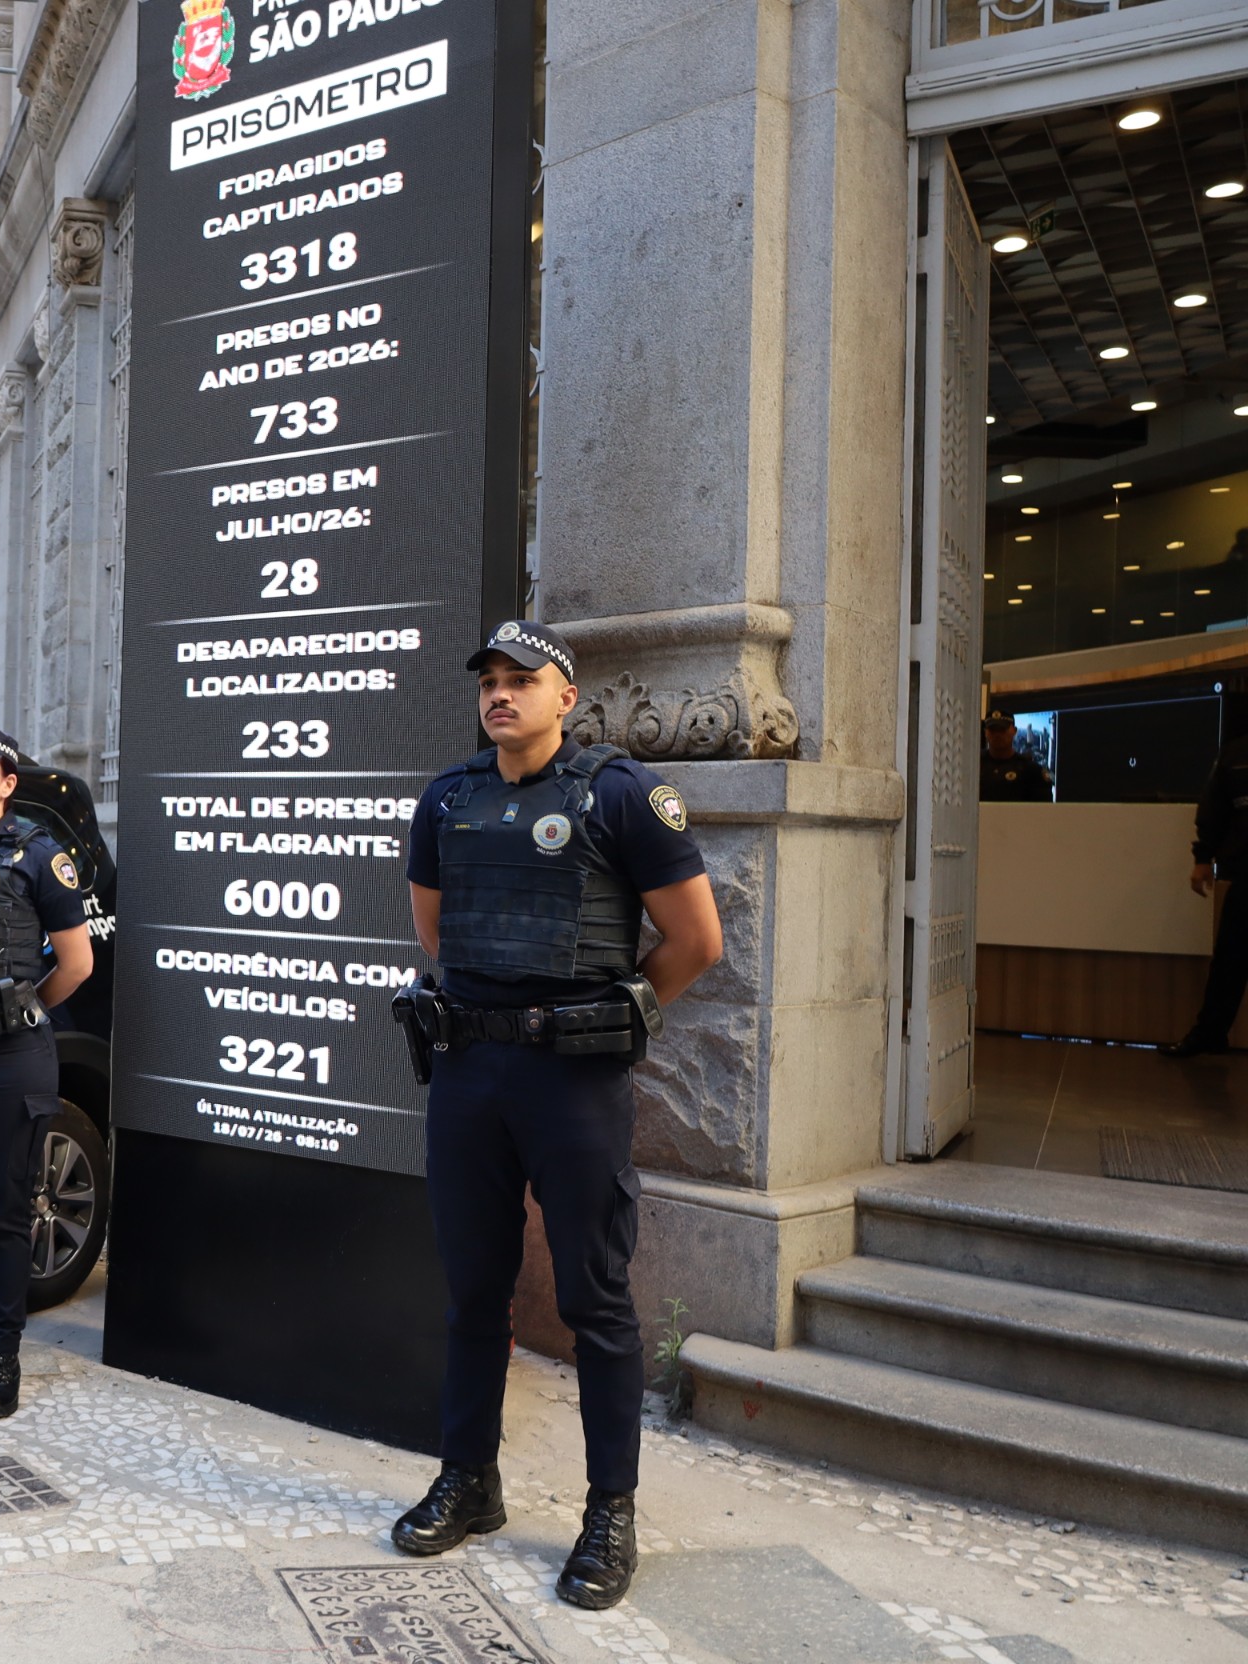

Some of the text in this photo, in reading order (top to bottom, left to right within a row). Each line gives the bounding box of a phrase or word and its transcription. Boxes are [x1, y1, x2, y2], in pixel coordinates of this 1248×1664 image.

[249, 0, 444, 63] SÃO PAU
[182, 57, 433, 156] PRISÔMETRO
[218, 138, 387, 200] FORAGIDOS
[203, 171, 404, 239] CAPTURADOS
[239, 232, 357, 290] 3318
[216, 303, 382, 354] PRESOS NO
[199, 338, 400, 392] ANO DE 2026:
[249, 396, 339, 445] 733
[212, 465, 378, 507] PRESOS EM
[215, 507, 372, 542] JULHO/26:
[259, 557, 319, 599] 28
[177, 628, 420, 663] DESAPARECIDOS
[186, 668, 396, 698] LOCALIZADOS:
[241, 718, 330, 759] 233
[161, 796, 417, 820] TOTAL DE PRESOS
[175, 831, 400, 858] EM FLAGRANTE:
[224, 879, 341, 920] 6000
[156, 949, 416, 989] OCORRÊNCIA COM
[204, 986, 356, 1022] VEÍCULOS:
[219, 1035, 330, 1084] 3221
[196, 1099, 359, 1136] ÚLTIMA ATUALIZAÇÃO
